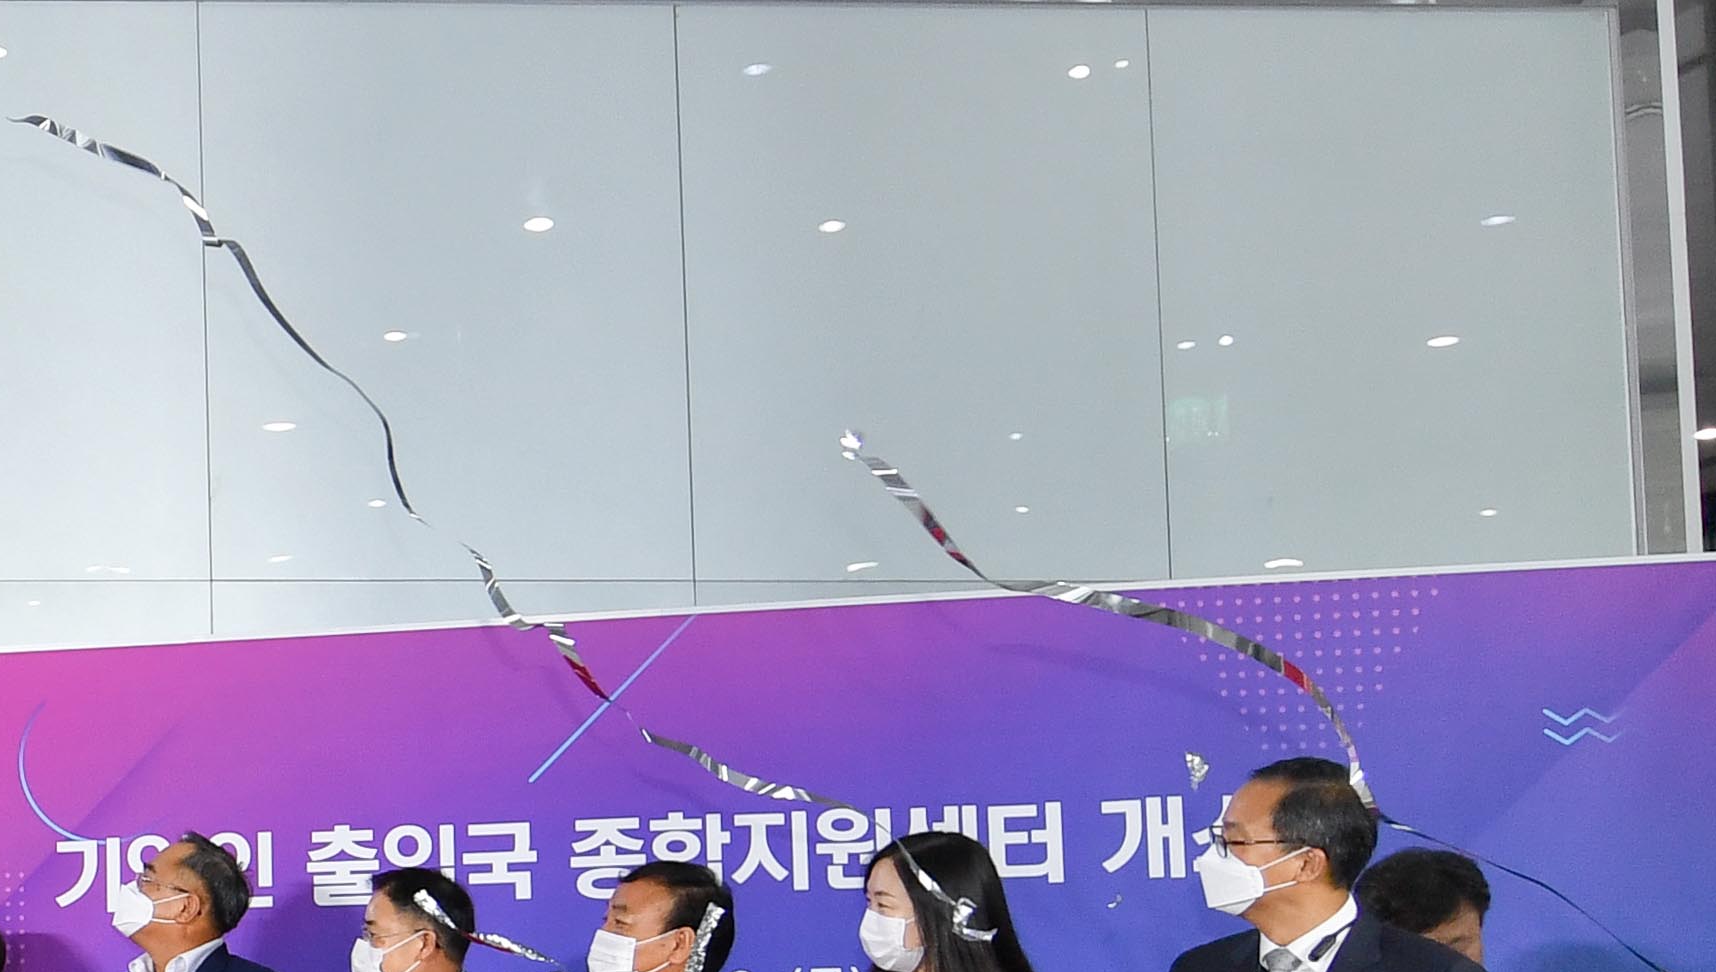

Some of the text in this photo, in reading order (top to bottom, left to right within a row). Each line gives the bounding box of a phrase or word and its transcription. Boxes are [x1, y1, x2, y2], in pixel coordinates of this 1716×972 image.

[54, 830, 274, 914] 기인
[305, 821, 539, 908] 출입국
[569, 800, 1067, 901] 종합지원터
